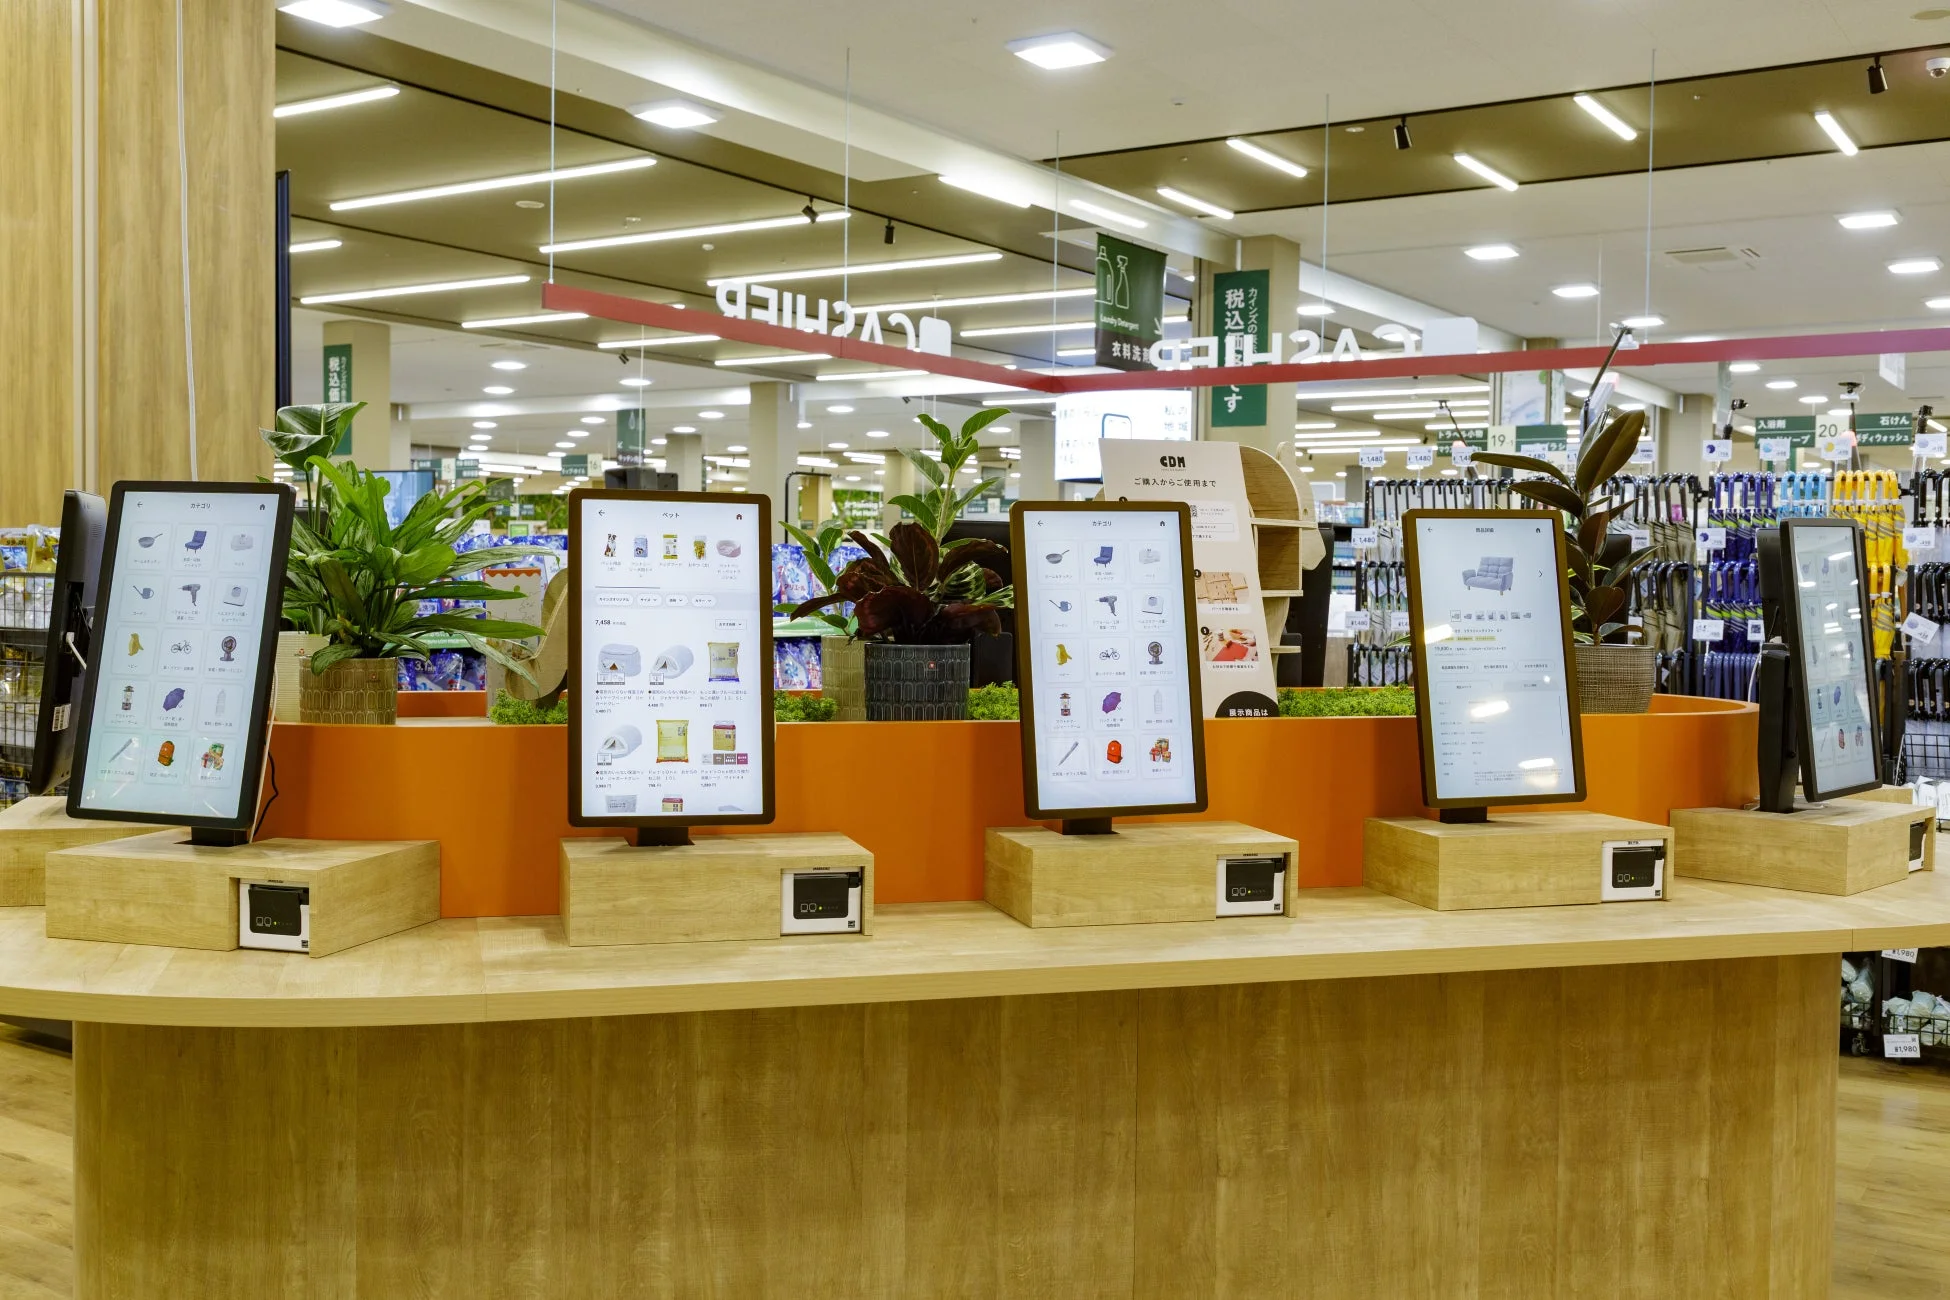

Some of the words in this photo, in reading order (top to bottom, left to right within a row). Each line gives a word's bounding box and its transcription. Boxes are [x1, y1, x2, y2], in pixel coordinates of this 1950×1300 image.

[1757, 419, 1786, 429] 入浴剤
[1879, 416, 1910, 425] 石けん
[1134, 478, 1217, 488] ご購入からご使用まで
[1228, 708, 1269, 717] 展示商品は
